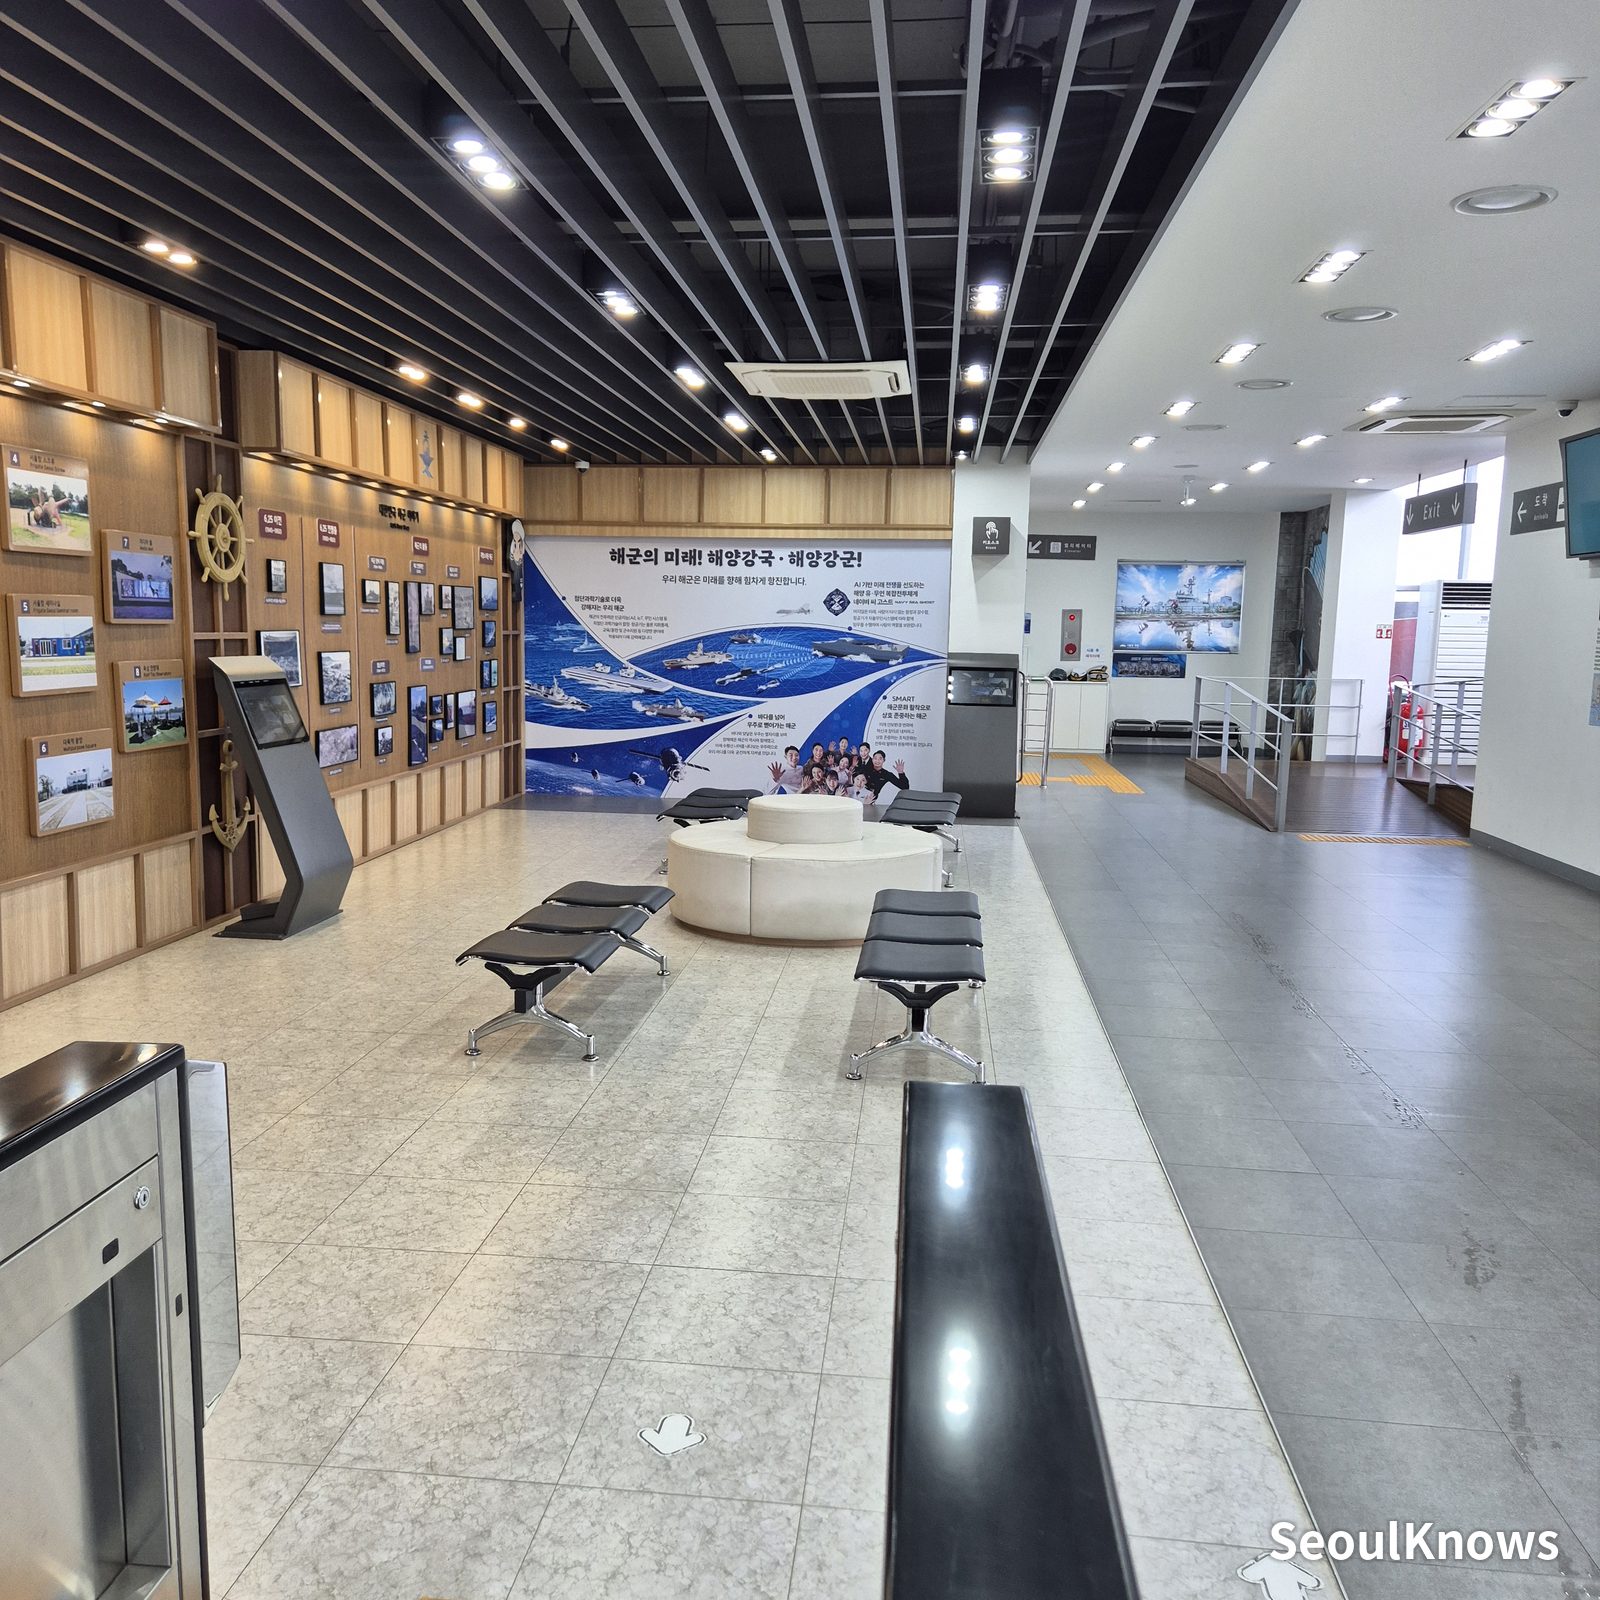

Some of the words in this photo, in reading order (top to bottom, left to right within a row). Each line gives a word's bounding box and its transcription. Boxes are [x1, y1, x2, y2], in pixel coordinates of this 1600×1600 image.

[12, 453, 18, 464] 4
[1534, 493, 1548, 507] 도착
[1423, 501, 1441, 520] Exit
[609, 548, 658, 566] 해군의
[664, 548, 703, 566] 미래!
[707, 549, 775, 568] 해양강국
[788, 550, 862, 568] 해양강군!
[662, 575, 677, 584] 우리
[678, 575, 701, 585] 해군은
[703, 575, 726, 585] 미래를
[727, 576, 742, 586] 향해
[744, 576, 766, 586] 힘차게
[768, 576, 807, 586] 항진합니다.
[22, 601, 28, 612] 5
[785, 722, 796, 730] 해군
[41, 743, 47, 753] 6
